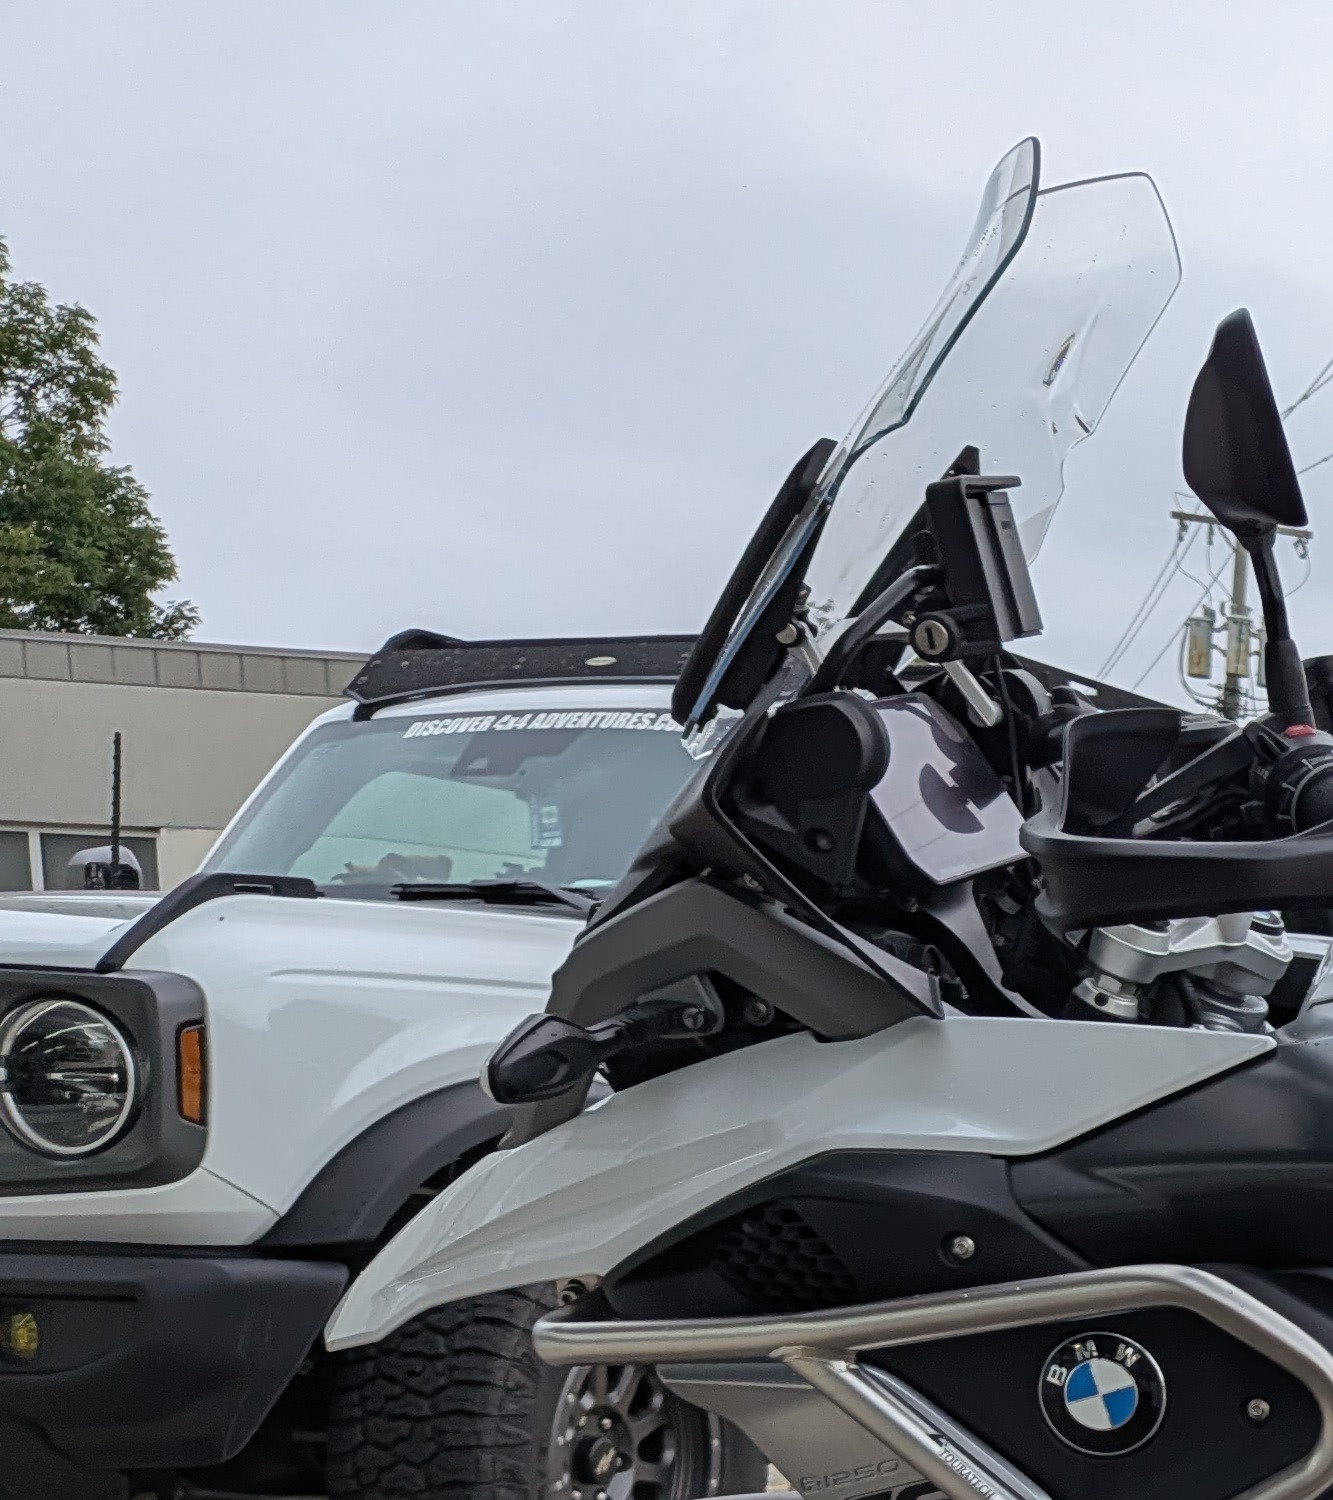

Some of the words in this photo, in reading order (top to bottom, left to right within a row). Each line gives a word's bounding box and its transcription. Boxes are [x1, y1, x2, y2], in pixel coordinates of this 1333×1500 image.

[403, 715, 496, 738] DISCOVER
[527, 711, 685, 732] ADVENTURES.CO
[1046, 1340, 1141, 1387] BMW
[939, 1448, 996, 1500] TOURATECH
